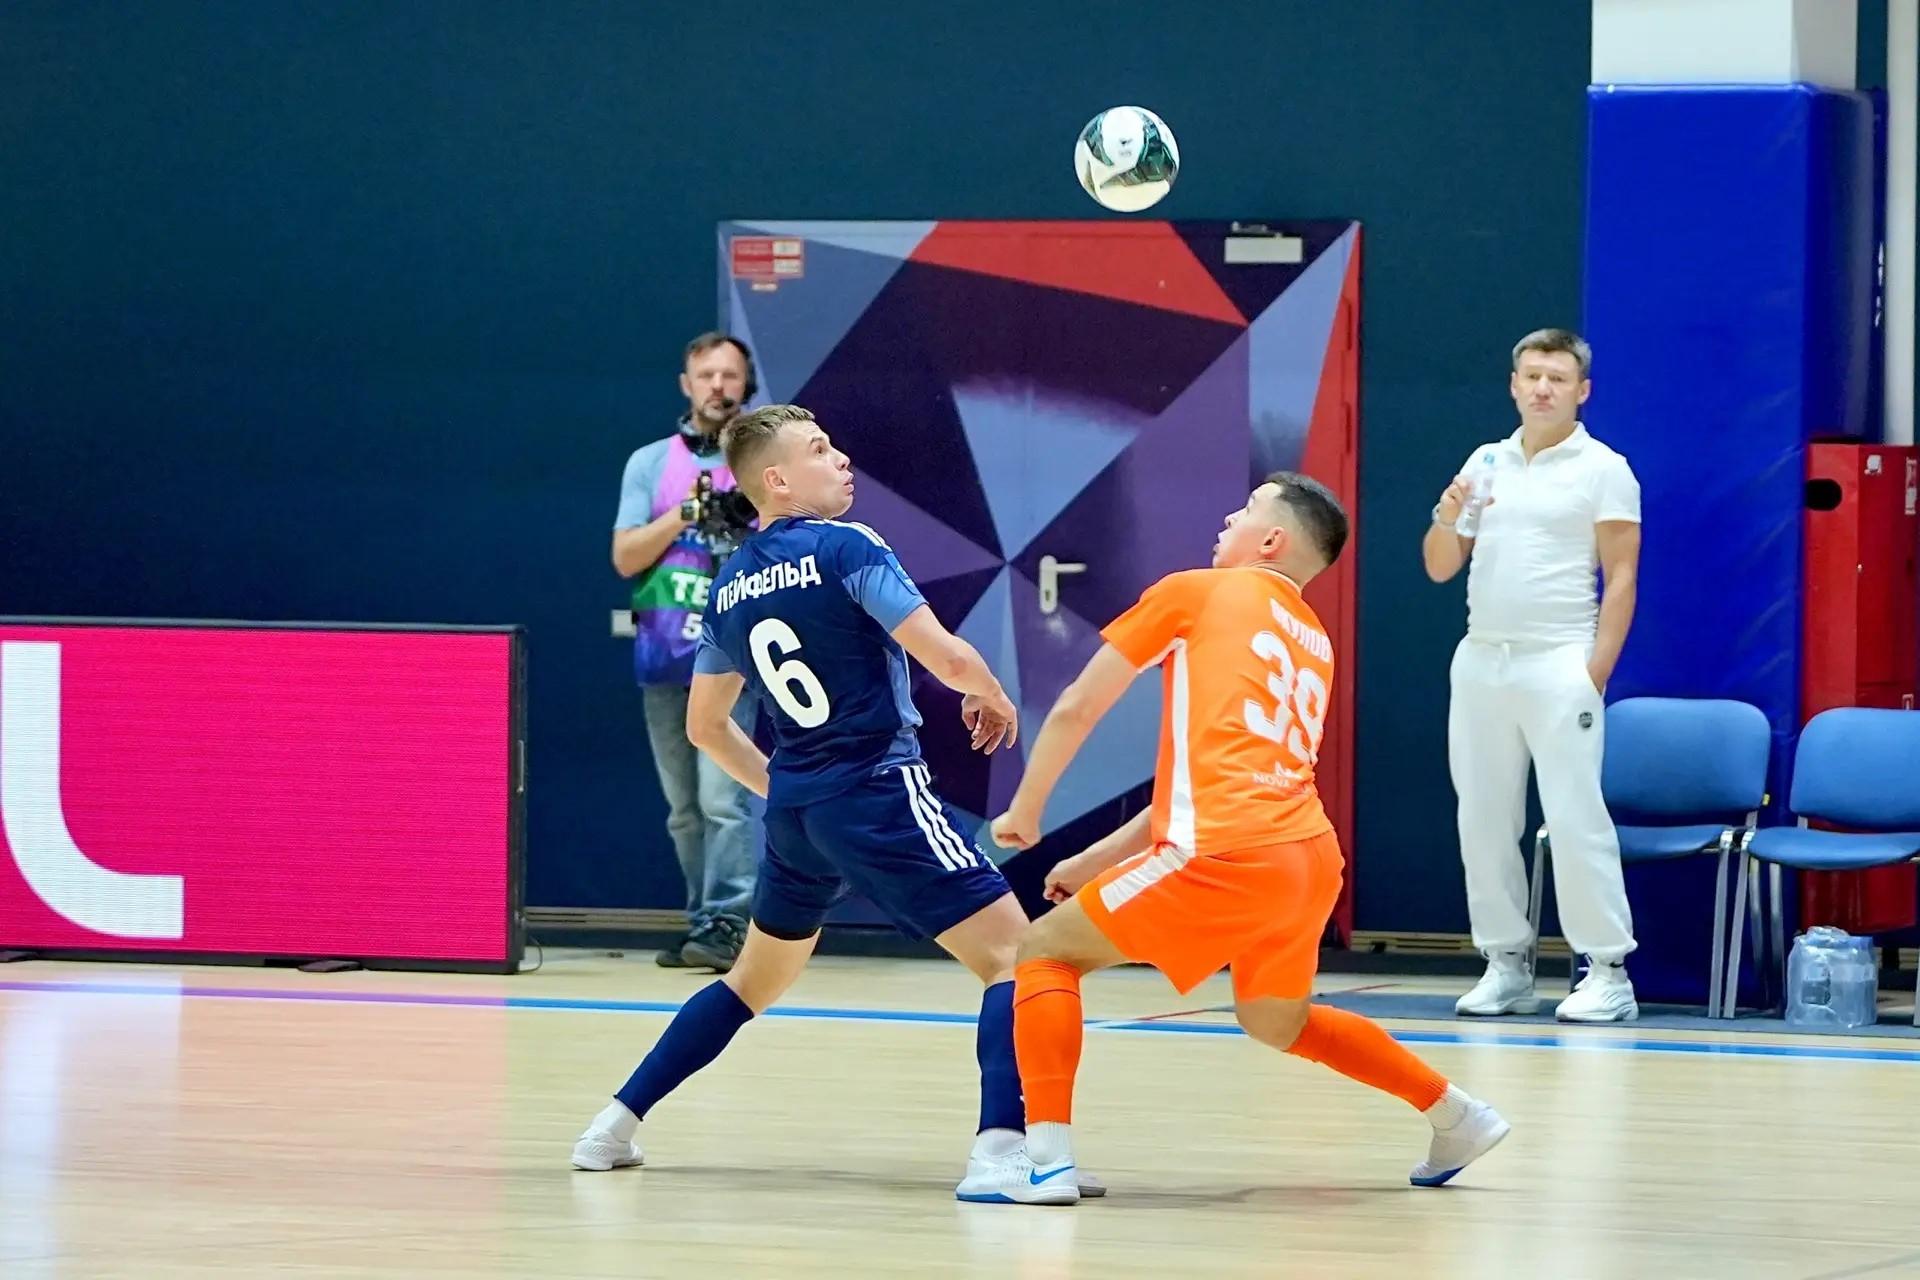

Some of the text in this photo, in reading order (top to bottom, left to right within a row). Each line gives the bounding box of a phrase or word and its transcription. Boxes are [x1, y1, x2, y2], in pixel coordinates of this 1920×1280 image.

[716, 554, 822, 614] ЛЕЙФЕЛЬД
[748, 617, 831, 729] 6
[1244, 631, 1327, 766] 39
